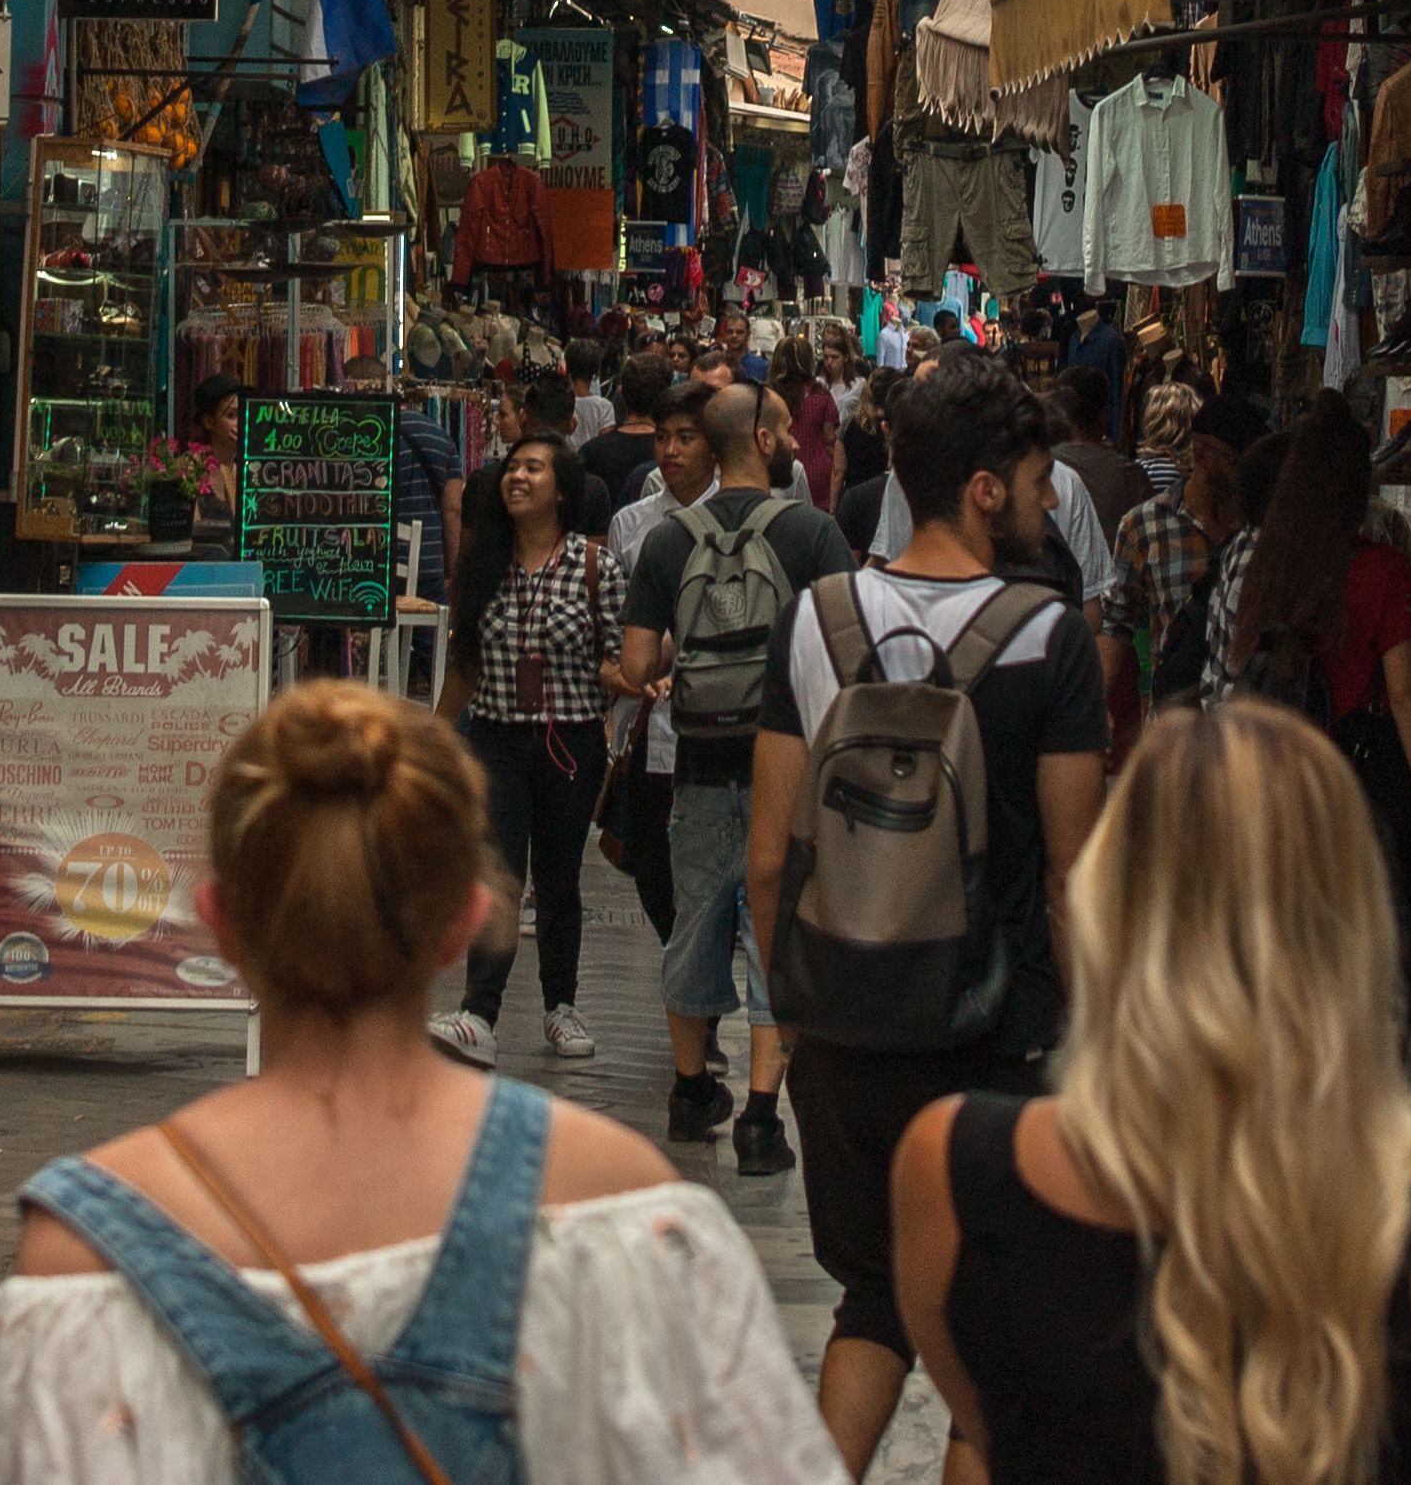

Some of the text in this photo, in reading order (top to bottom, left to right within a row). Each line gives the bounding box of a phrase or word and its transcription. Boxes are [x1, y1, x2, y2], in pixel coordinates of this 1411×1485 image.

[512, 74, 530, 95] R
[1243, 216, 1282, 247] Athens
[256, 404, 340, 427] NUTELLA
[262, 461, 373, 490] GRANITAS
[263, 569, 305, 594] REE
[57, 623, 171, 674] SALE
[62, 674, 164, 696] All Brands
[147, 736, 230, 756] Superdry
[142, 818, 212, 830] TOM FOR
